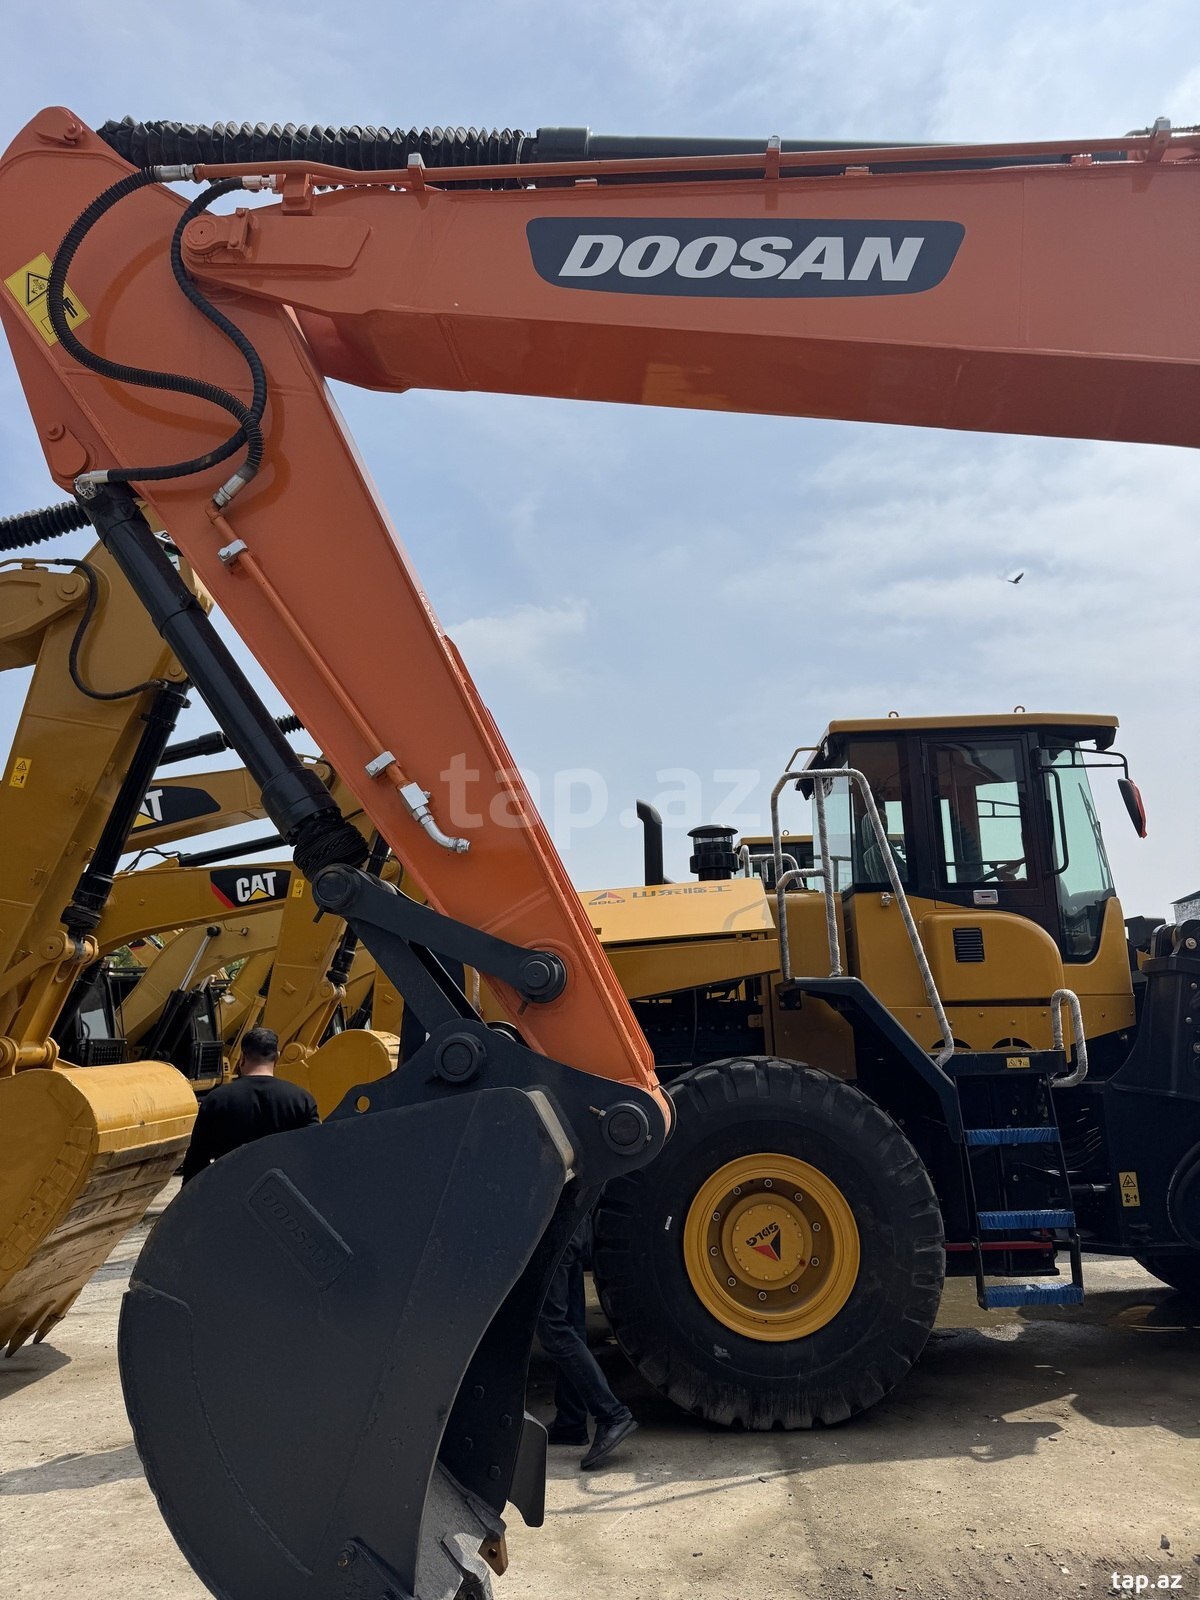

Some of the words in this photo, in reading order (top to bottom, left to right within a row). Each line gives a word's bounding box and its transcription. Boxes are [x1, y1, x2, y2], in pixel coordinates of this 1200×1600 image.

[558, 235, 925, 281] DOOSAN
[236, 871, 277, 902] CAT
[260, 1190, 341, 1271] DOOSAN
[745, 1221, 779, 1247] SDLG
